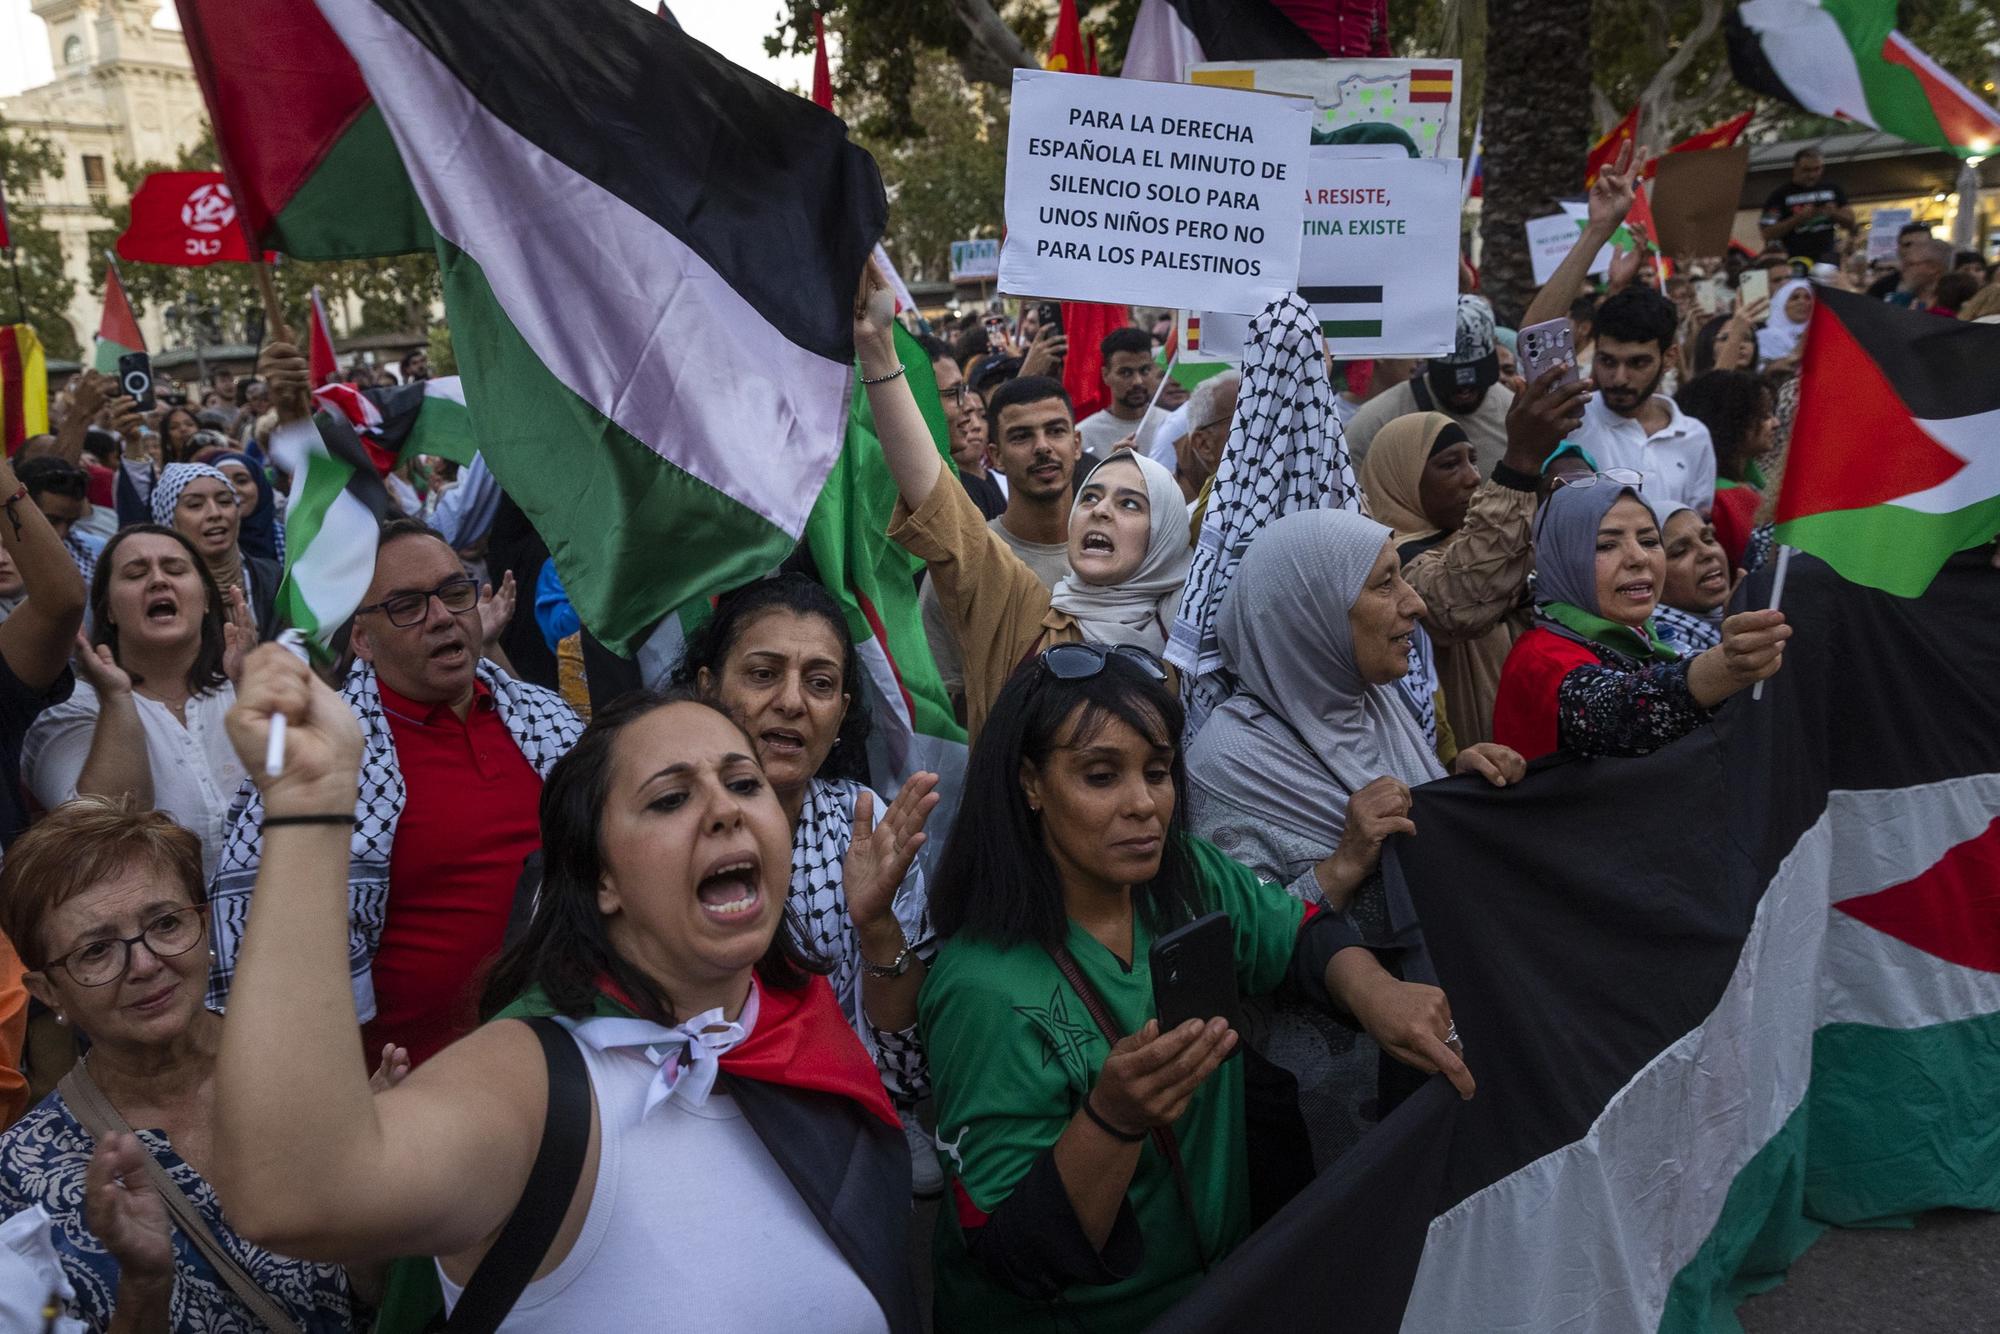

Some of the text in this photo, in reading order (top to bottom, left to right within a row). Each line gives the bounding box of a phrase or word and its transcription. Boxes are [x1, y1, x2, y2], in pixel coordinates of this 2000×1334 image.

[1069, 107, 1254, 144] PARA LA DERECHA
[1028, 137, 1287, 181] ESPAÑOLA EL MINUTO DE
[1049, 173, 1260, 212] SILENCIO SOLO PARA
[1318, 188, 1391, 207] RESISTE,
[1039, 206, 1265, 245] UNOS NIÑOS PERO NO
[1303, 219, 1406, 236] TINA EXISTE
[1036, 239, 1261, 277] PARA LOS PALESTINOS
